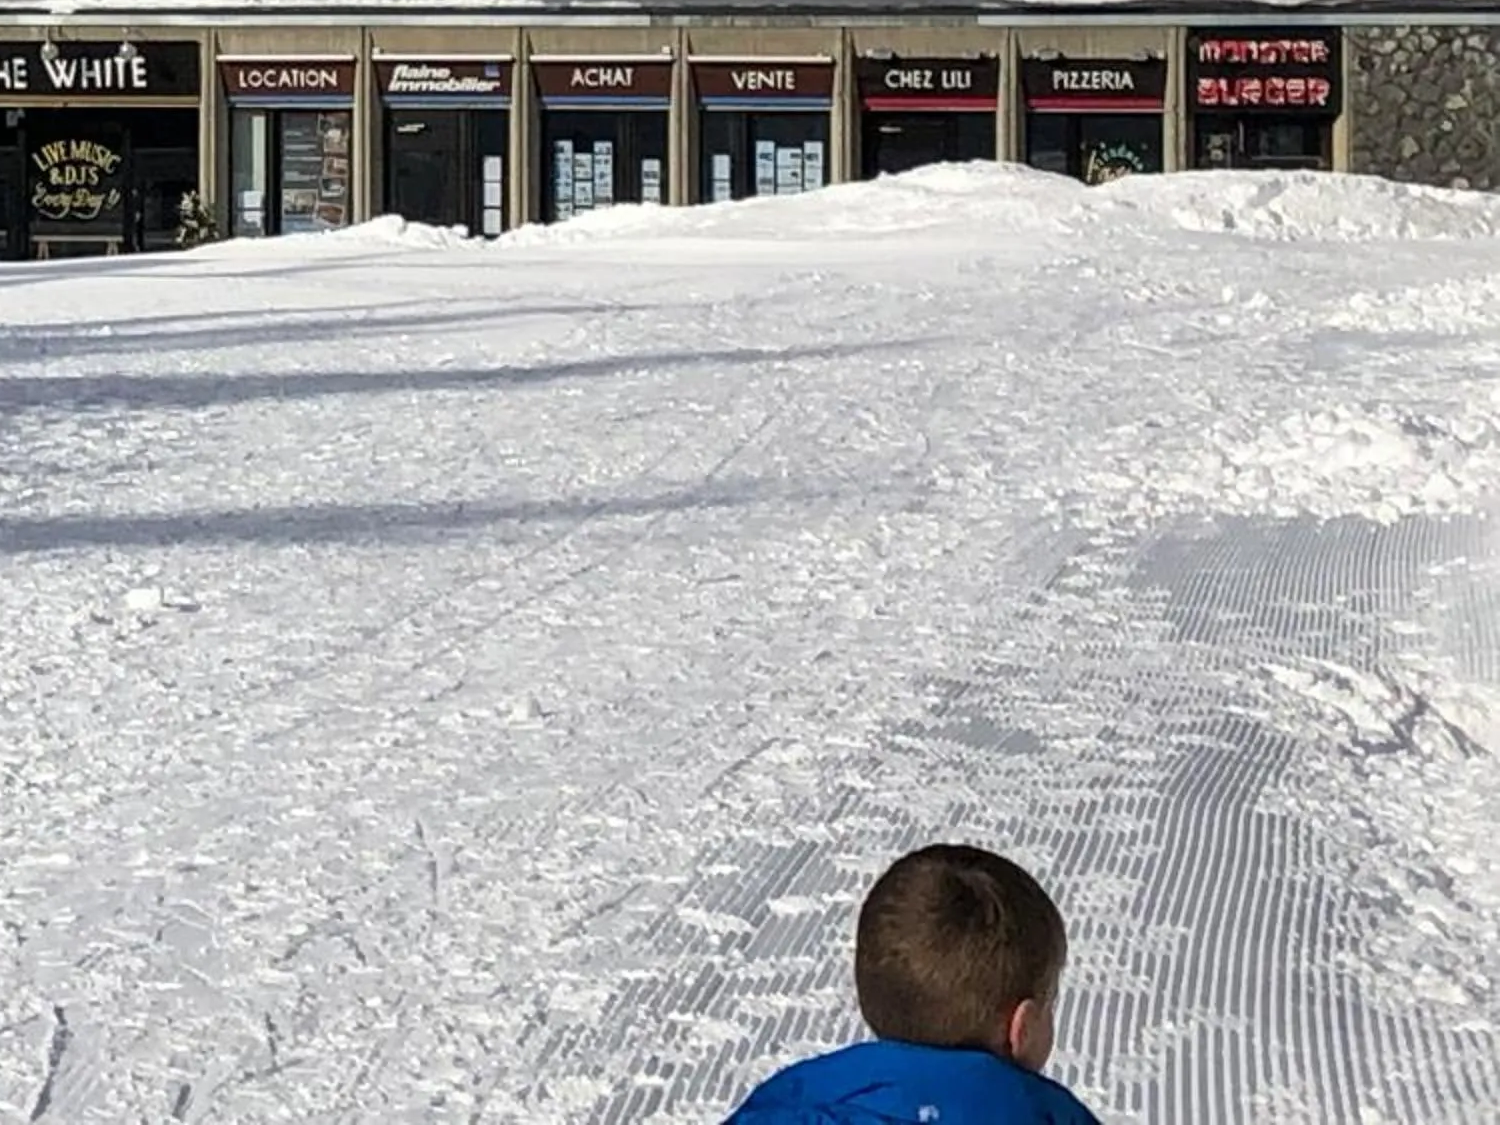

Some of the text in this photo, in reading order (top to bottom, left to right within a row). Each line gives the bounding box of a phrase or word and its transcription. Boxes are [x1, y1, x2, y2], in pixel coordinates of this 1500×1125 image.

[43, 57, 148, 89] WHITE
[239, 68, 338, 88] LOCATION
[571, 67, 634, 87] ACHAT
[731, 69, 795, 90] VENTE
[885, 69, 971, 89] CHEZ LILI
[1053, 70, 1134, 90] PIZZERIA
[1197, 77, 1330, 106] BURGER
[32, 139, 122, 174] LIVE MUSIC
